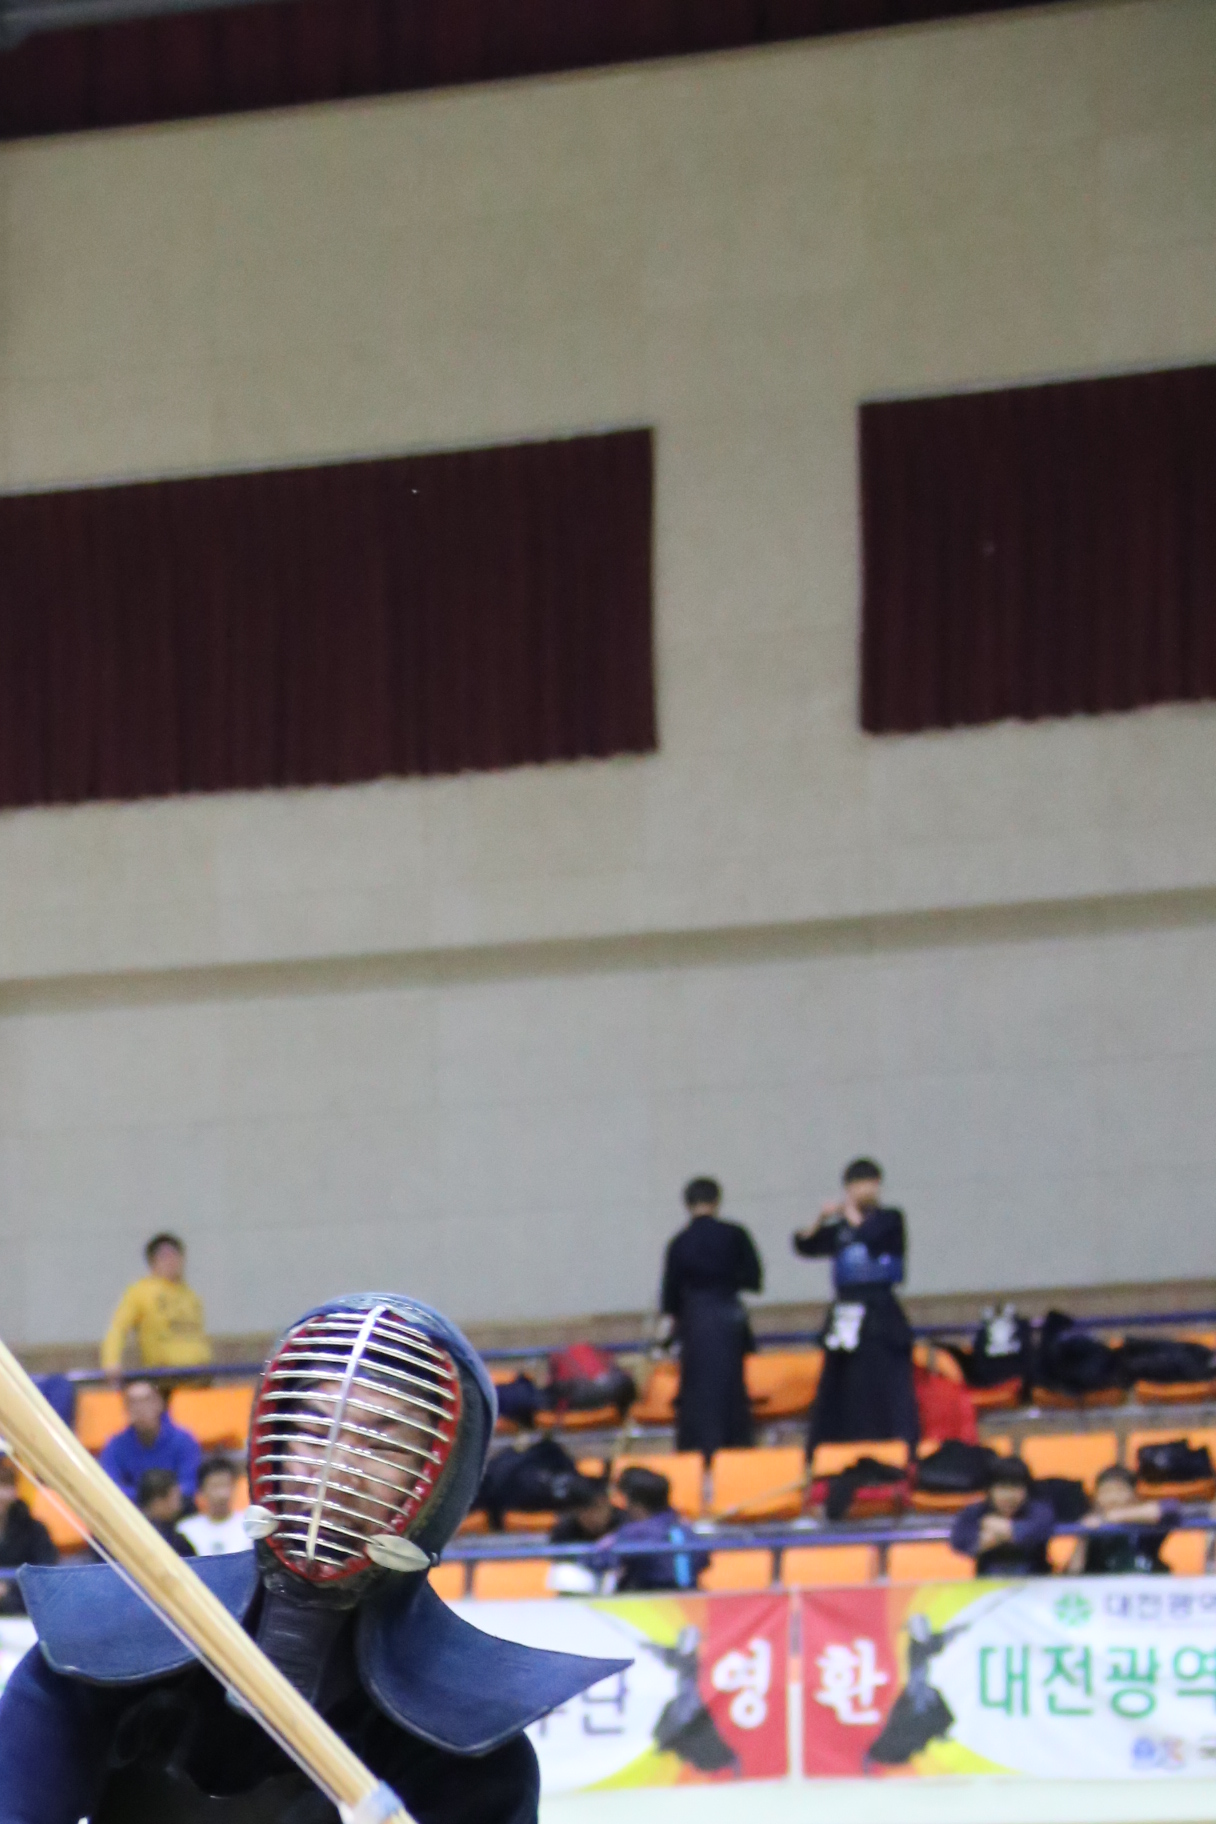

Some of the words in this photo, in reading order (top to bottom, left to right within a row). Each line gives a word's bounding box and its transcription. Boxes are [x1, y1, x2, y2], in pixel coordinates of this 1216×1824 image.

[712, 1636, 772, 1729] 영
[813, 1637, 889, 1727] 환
[979, 1642, 1216, 1719] 대전광역
